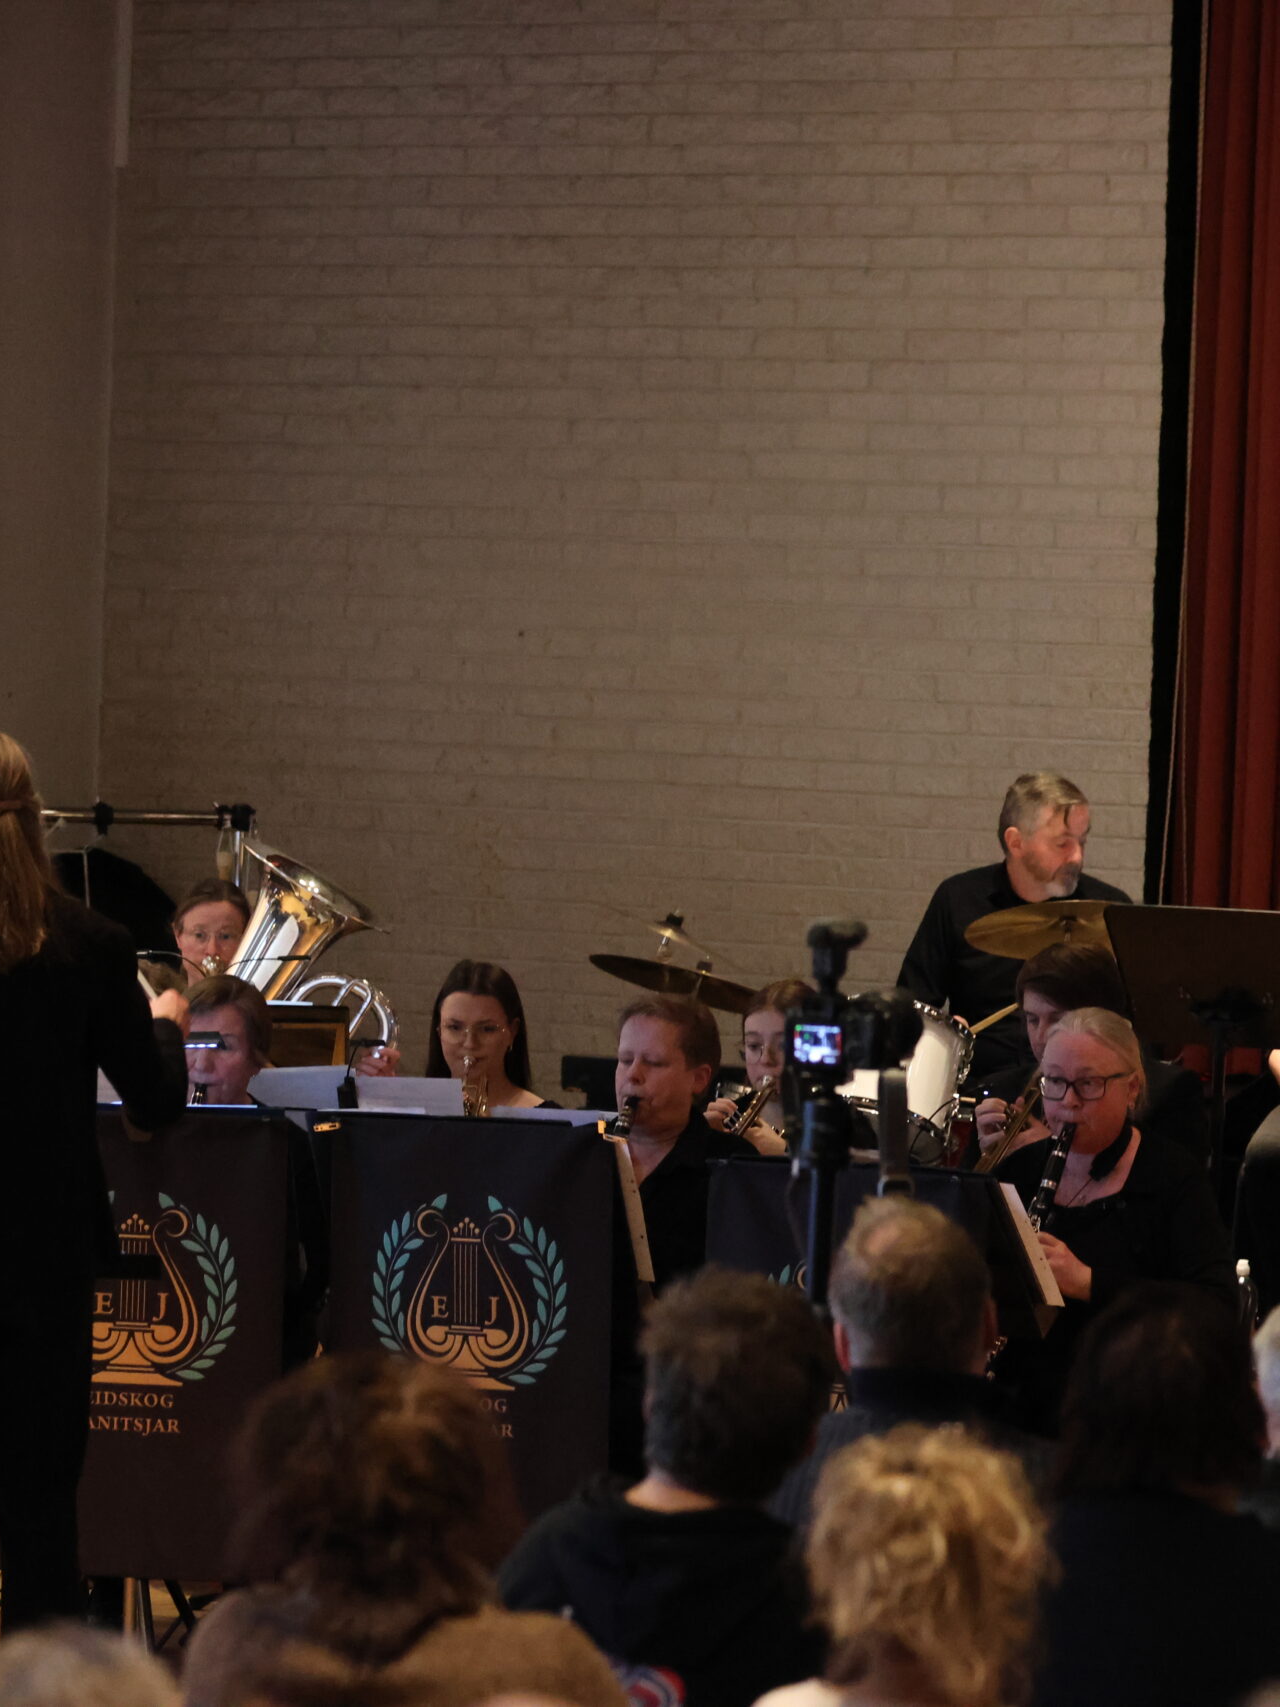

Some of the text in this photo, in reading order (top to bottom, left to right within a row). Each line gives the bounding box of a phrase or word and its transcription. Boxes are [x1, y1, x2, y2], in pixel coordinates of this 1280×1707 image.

[93, 1291, 169, 1322] E J
[430, 1295, 500, 1326] E J
[90, 1391, 175, 1408] IDSKOG
